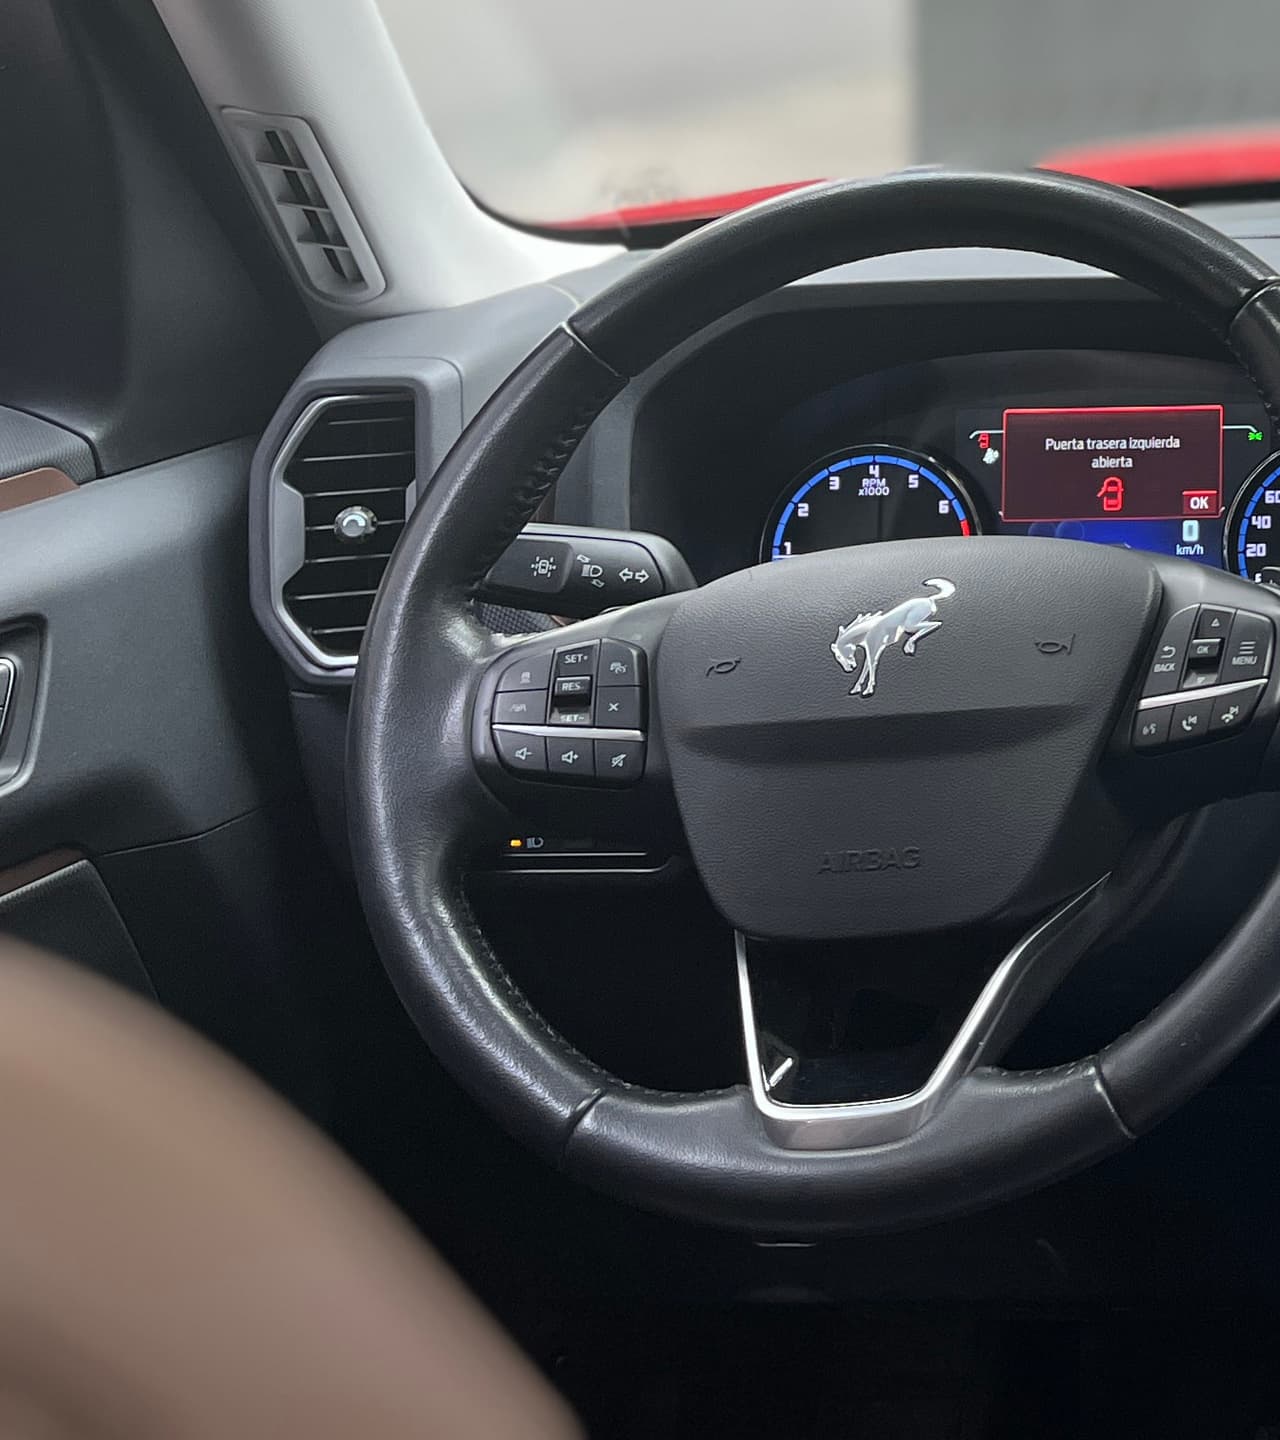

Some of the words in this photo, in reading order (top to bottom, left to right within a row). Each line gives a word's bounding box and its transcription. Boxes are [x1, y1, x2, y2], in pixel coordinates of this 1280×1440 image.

[1046, 438, 1084, 450] Puerta
[1087, 438, 1127, 450] trasera
[1129, 436, 1180, 451] izquierda
[1092, 456, 1132, 468] abierta
[869, 465, 880, 478] 4
[829, 476, 840, 490] 3
[862, 478, 886, 488] RPM
[908, 474, 919, 488] 5
[858, 486, 890, 496] x1000
[938, 500, 949, 514] 6
[1190, 497, 1208, 509] OK
[797, 503, 809, 517] 2
[1251, 516, 1271, 529] 40
[784, 541, 792, 555] 1
[1176, 544, 1204, 555] km/h
[1246, 543, 1267, 557] 20
[1197, 646, 1209, 654] OK
[1232, 656, 1257, 665] MENU
[1154, 663, 1176, 672] BACK
[562, 682, 581, 691] RES
[818, 846, 920, 874] AIRBAG
